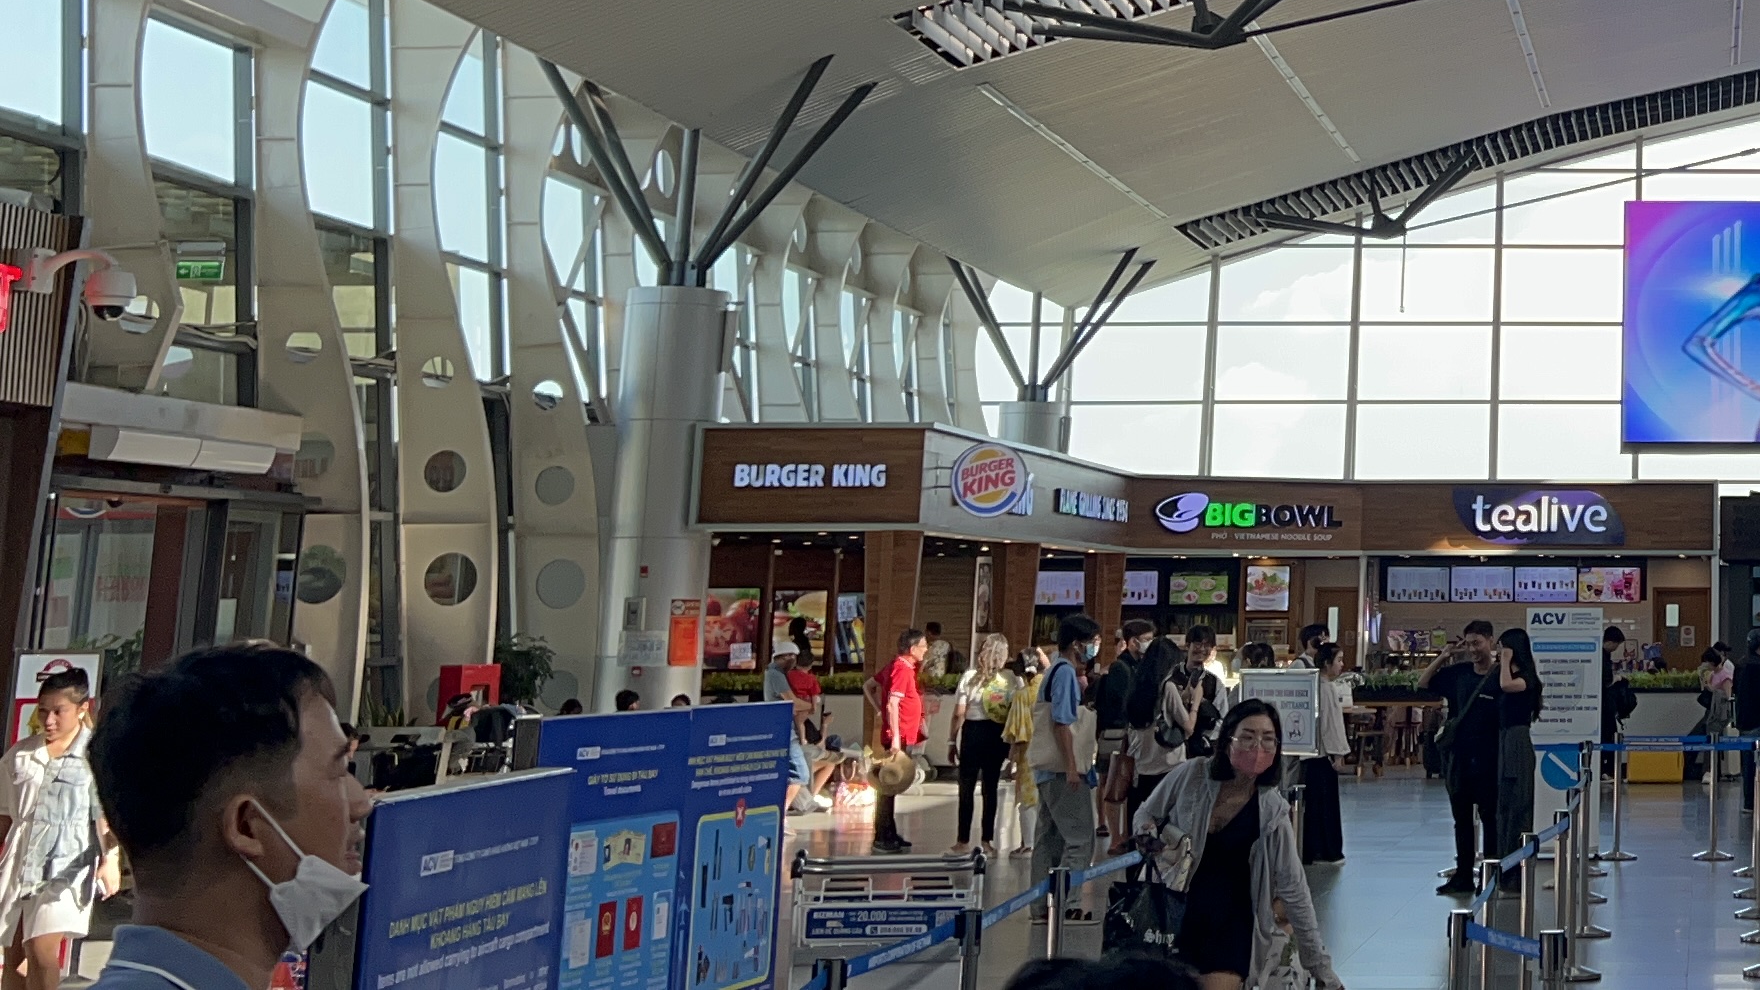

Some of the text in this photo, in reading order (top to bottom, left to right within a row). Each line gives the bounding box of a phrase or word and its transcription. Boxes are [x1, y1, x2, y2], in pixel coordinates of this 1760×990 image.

[733, 463, 887, 488] BURGER KING
[961, 457, 1015, 481] BURGER
[962, 470, 1016, 499] KING
[1472, 495, 1608, 534] tealive
[1281, 533, 1311, 541] NOODLE
[1313, 533, 1333, 541] SOUP
[1531, 612, 1566, 625] ACV
